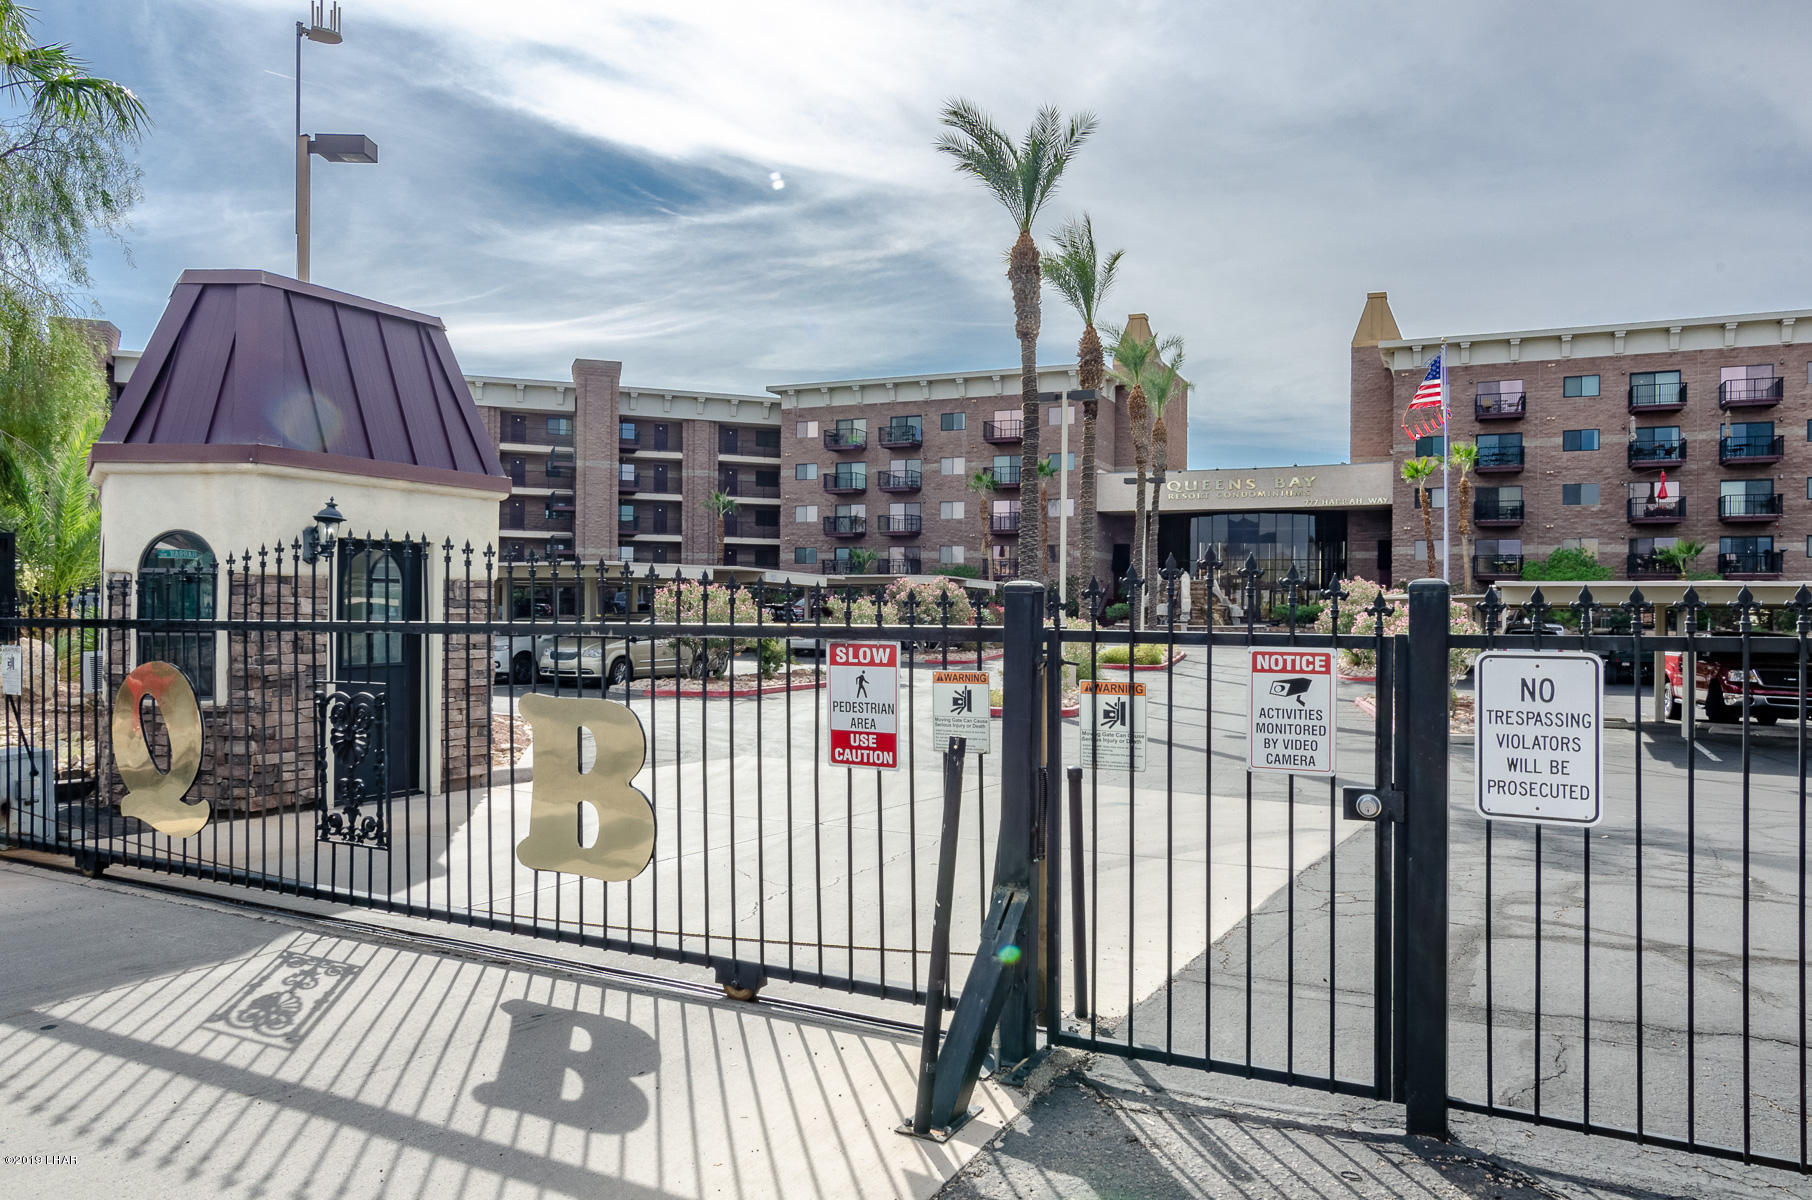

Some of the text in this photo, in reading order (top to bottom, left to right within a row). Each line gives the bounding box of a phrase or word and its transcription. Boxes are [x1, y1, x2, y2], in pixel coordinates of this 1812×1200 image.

[1167, 476, 1317, 492] QUEENS BAY
[836, 647, 890, 664] SLOW
[1256, 654, 1326, 671] NOTICE
[944, 673, 987, 682] WARNING
[1094, 683, 1144, 694] WARNIG
[1520, 677, 1555, 703] NO
[832, 700, 895, 715] PEDESTRIAN
[1259, 707, 1323, 721] ACTIVITIES
[850, 717, 876, 730] AREA
[1486, 709, 1592, 729] TRESPASSING
[1082, 730, 1100, 738] Movg
[1255, 722, 1327, 736] MONITORED
[850, 733, 877, 748] USE
[1264, 738, 1318, 752] BY VIDEO
[1496, 733, 1582, 752] VIOLATORS
[834, 747, 893, 765] CAUTION
[1266, 753, 1316, 767] CAMERA
[112, 661, 657, 882] Q B
[1507, 757, 1570, 775] WILL BE
[1487, 779, 1590, 800] PROSECUTED
